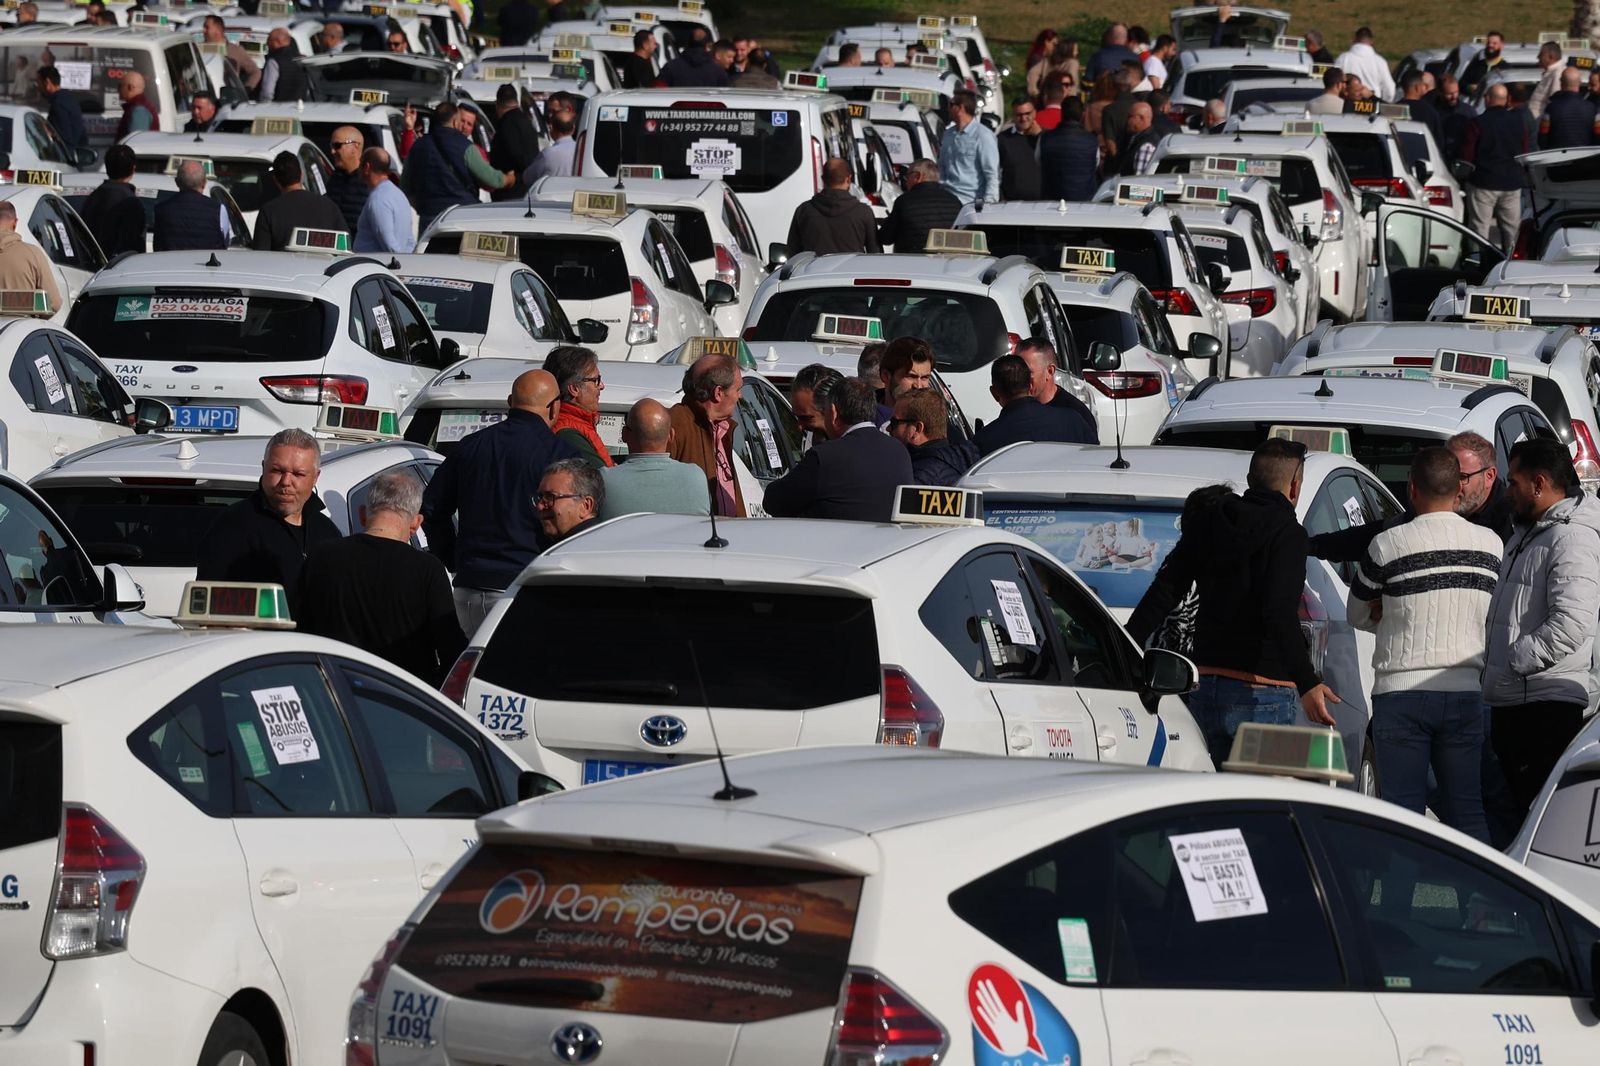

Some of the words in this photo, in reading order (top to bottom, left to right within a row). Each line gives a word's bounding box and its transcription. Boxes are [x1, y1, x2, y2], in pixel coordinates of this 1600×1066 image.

[645, 110, 755, 120] WWW.TAXISOLMARBELLA.COM
[1354, 101, 1373, 112] TAXI
[660, 123, 683, 132] (+34)
[685, 124, 701, 132] 952
[727, 124, 739, 132] 88
[694, 149, 734, 159] STOP
[27, 170, 51, 184] TAXI
[591, 194, 613, 209] TAXI
[480, 235, 506, 252] TAXI
[1201, 236, 1226, 244] taxi
[1077, 250, 1103, 265] TAXI
[152, 304, 177, 312] 952
[180, 304, 198, 312] 04
[203, 305, 220, 313] 04
[224, 306, 243, 314] 04
[1484, 297, 1517, 316] TAXI
[705, 341, 737, 355] TAXI
[115, 364, 143, 374] TAXI
[143, 383, 223, 391] KUGA
[198, 409, 234, 427] MPD
[918, 490, 962, 517] TAXI
[985, 517, 1001, 525] EL
[1004, 516, 1057, 524] CUERPO
[261, 700, 301, 724] STOP
[481, 694, 527, 713] TAXI
[269, 720, 309, 739] ABUSOS
[477, 711, 524, 731] 1372
[1047, 729, 1072, 747] TOYOTA
[1212, 837, 1244, 848] ABUSIVAS
[1201, 853, 1220, 861] sector
[1233, 849, 1247, 857] TAXI
[1213, 863, 1243, 880] BASTA
[621, 884, 736, 905] Restaurante
[1218, 881, 1235, 898] YA
[1235, 880, 1246, 897] !!
[545, 884, 795, 945] Rompeolas
[534, 927, 611, 948] Especialidad
[614, 938, 629, 948] en
[639, 935, 700, 957] Pescados
[700, 947, 715, 965] y
[716, 946, 779, 969] Mariscos
[392, 989, 439, 1017] TAXI
[386, 1014, 433, 1040] 1091
[1492, 1014, 1536, 1033] TAXI
[1504, 1044, 1543, 1065] 1091
